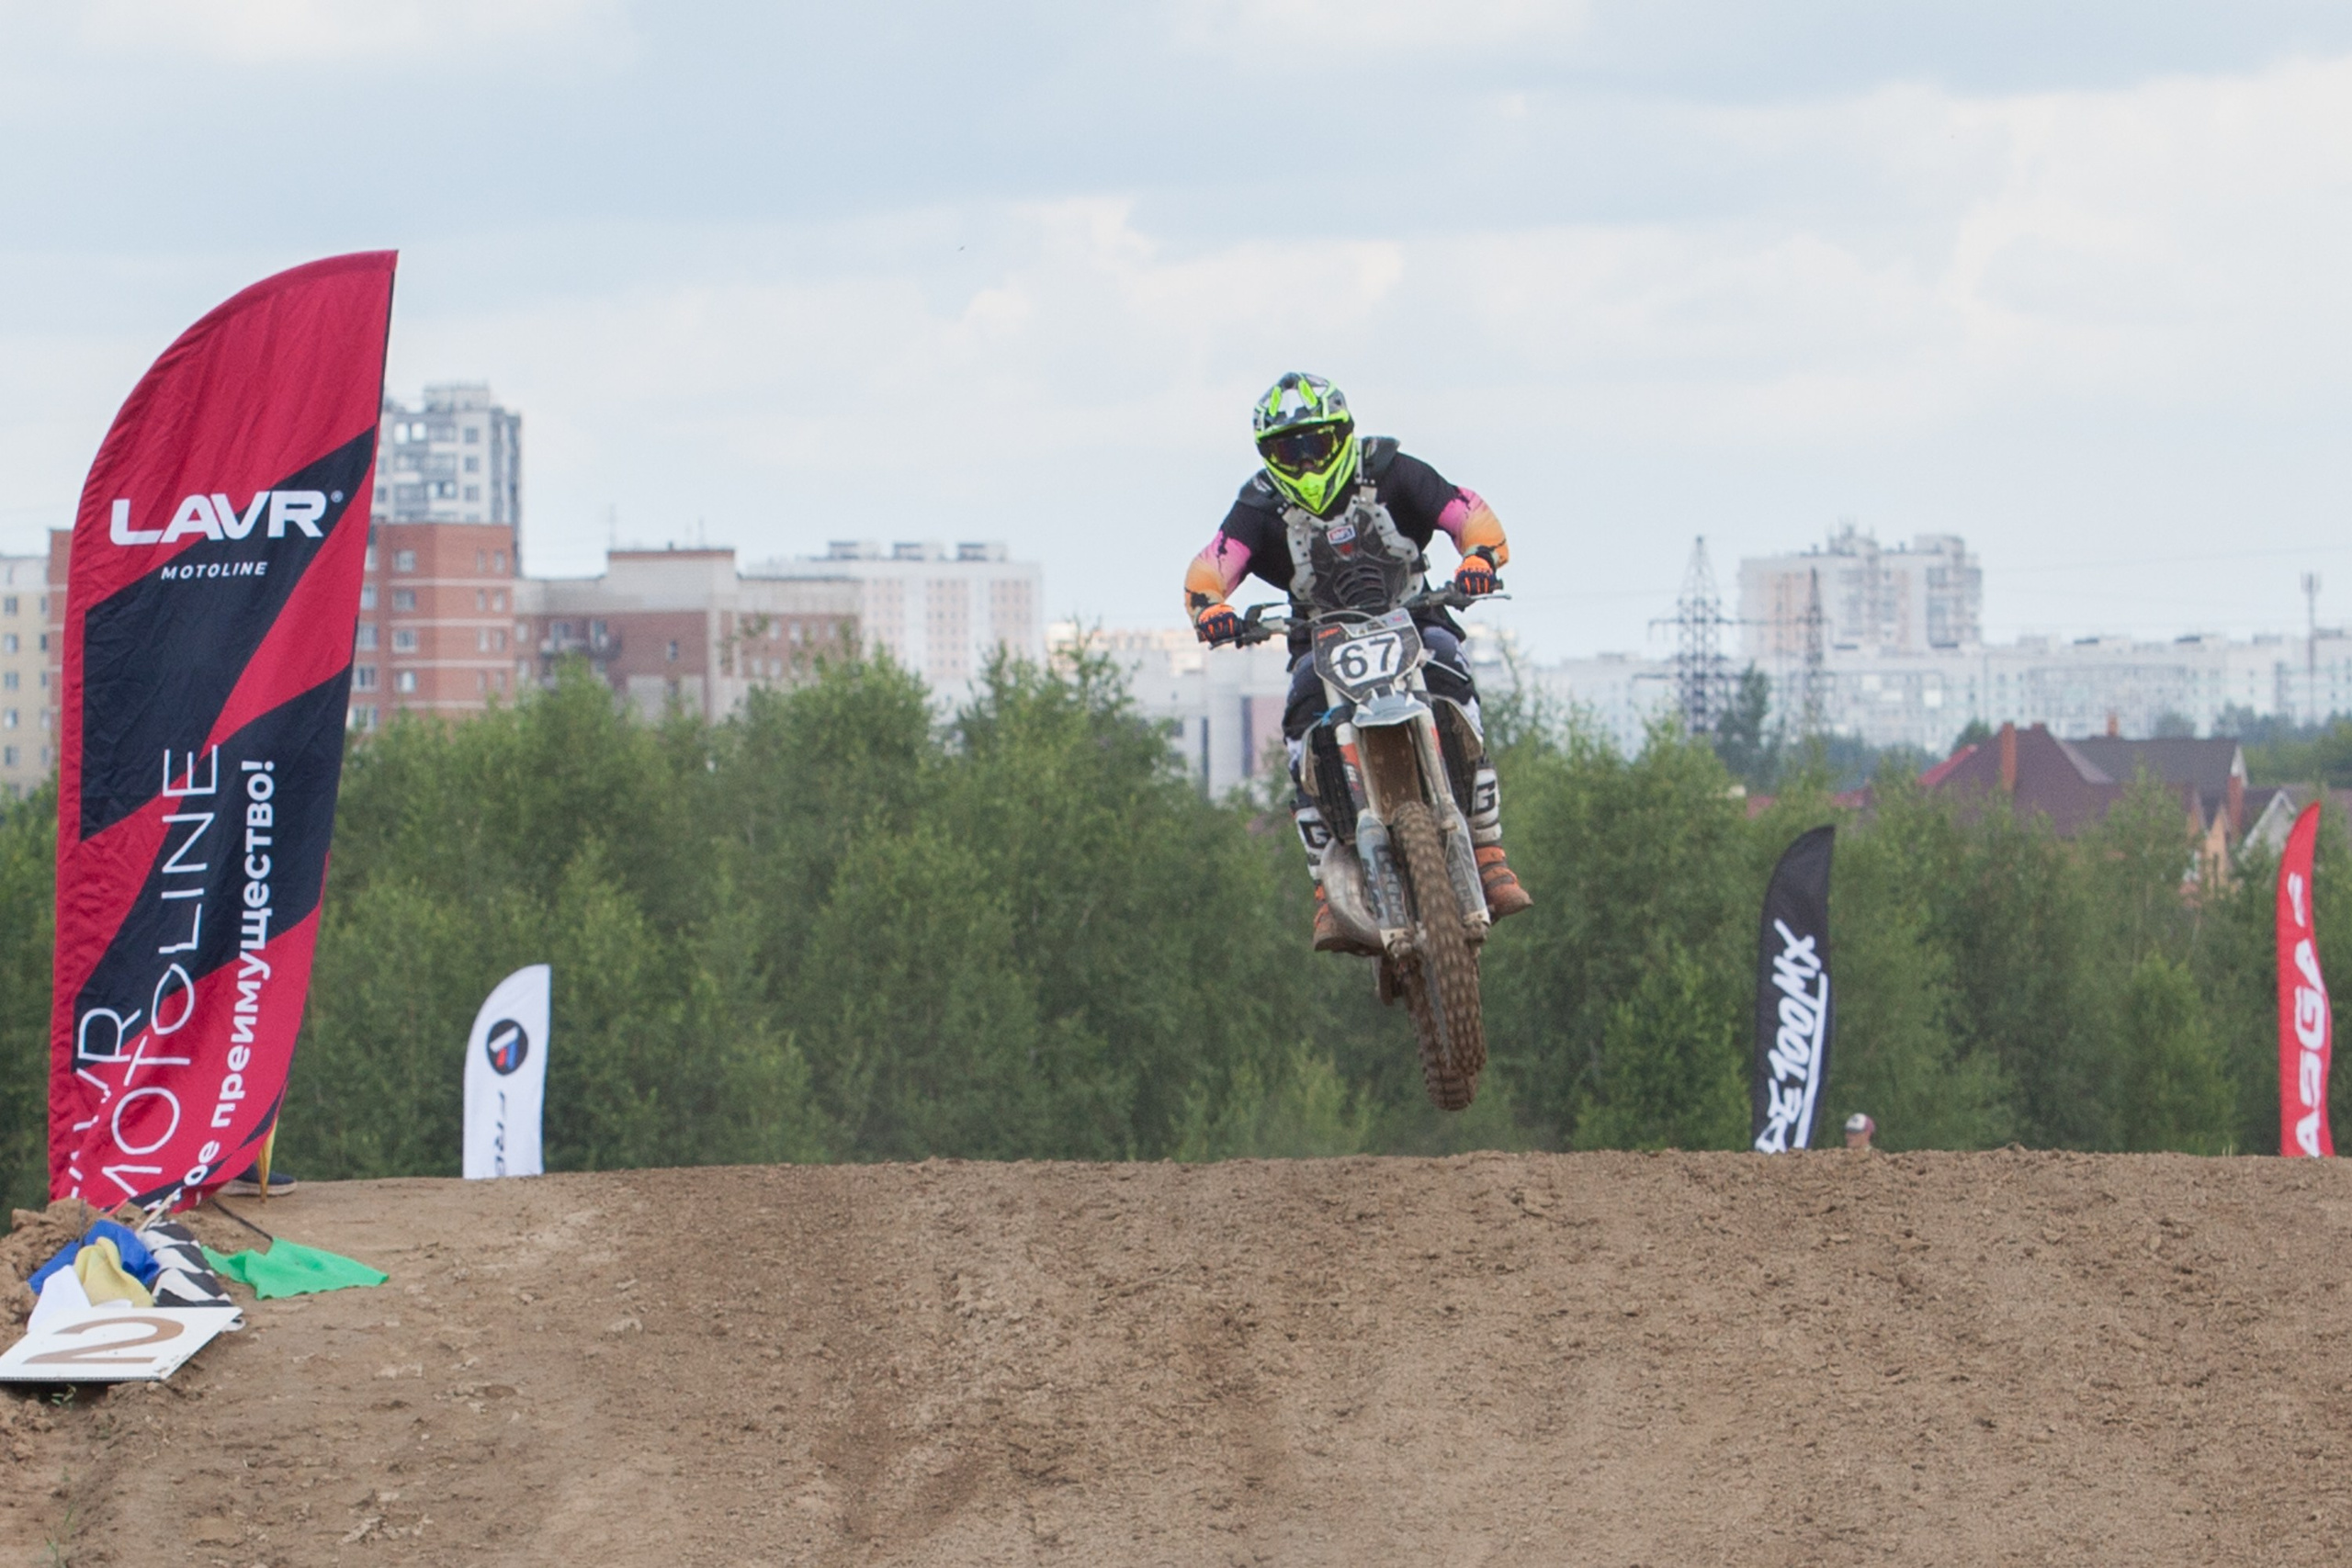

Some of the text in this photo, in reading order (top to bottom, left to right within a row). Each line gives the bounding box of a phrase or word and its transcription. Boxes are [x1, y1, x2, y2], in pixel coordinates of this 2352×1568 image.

[109, 490, 324, 546] LAVR
[161, 560, 268, 581] MOTOLINE
[1340, 636, 1396, 680] 67
[210, 760, 276, 1128] преимущество!
[23, 1315, 186, 1365] 2
